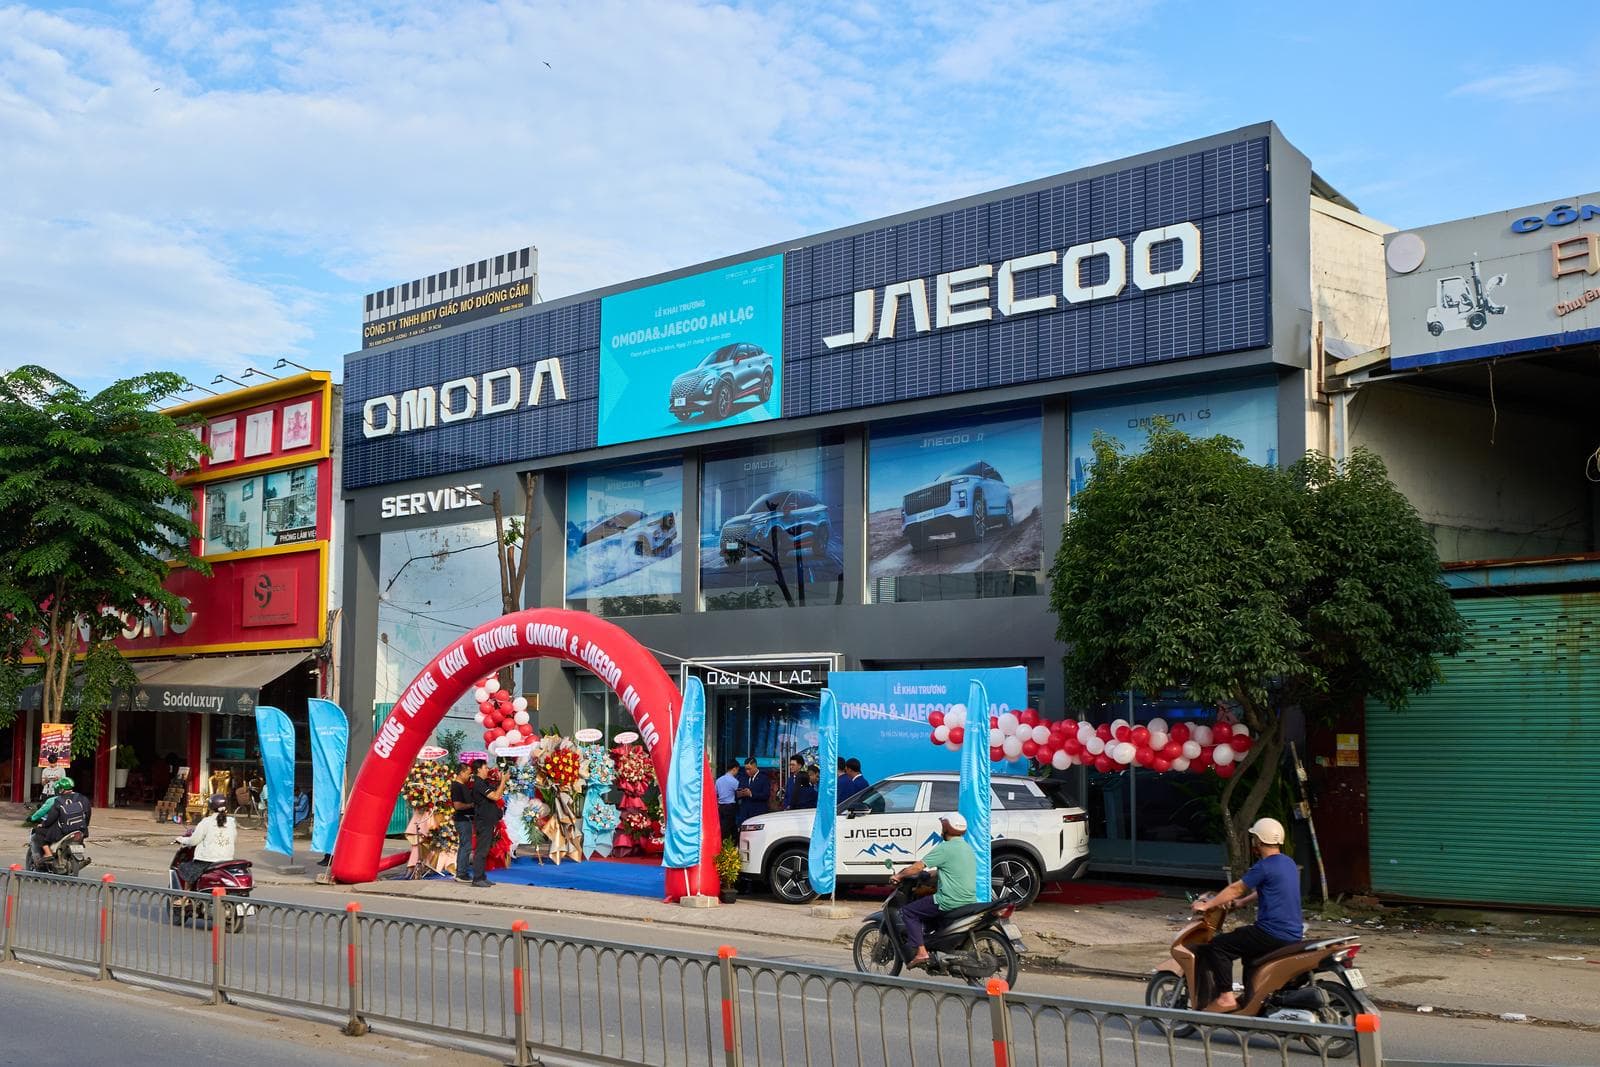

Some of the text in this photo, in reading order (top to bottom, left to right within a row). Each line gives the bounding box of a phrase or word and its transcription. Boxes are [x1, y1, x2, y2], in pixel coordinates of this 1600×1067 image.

[823, 222, 1201, 349] JAECOO
[364, 323, 386, 338] CÔNG
[387, 319, 397, 332] TY
[398, 313, 419, 329] TNHH
[420, 308, 437, 323] MTV
[460, 296, 474, 312] MƠ
[475, 289, 507, 308] DƯƠNG
[663, 303, 678, 316] KHAI
[611, 315, 707, 348] OMODA&JAECOO
[709, 311, 727, 328] AN
[729, 305, 754, 325] LẠC
[363, 357, 566, 439] OMODA
[381, 483, 483, 519] SERVICE
[374, 716, 405, 759] CHÚC
[438, 644, 469, 680] KHAI
[472, 624, 519, 658] TRƯƠNG
[526, 622, 569, 652] OMODA
[569, 635, 579, 657] &
[580, 640, 622, 690] JAECOO
[622, 685, 641, 716] AN
[707, 671, 740, 685] O&J
[747, 671, 771, 685] AN
[902, 685, 918, 695] KHAI
[918, 684, 946, 695] TRƯƠNG
[163, 691, 224, 712] Sodoluxury
[841, 702, 887, 720] OMODA
[889, 703, 899, 720] &
[844, 828, 912, 839] JAECOO
